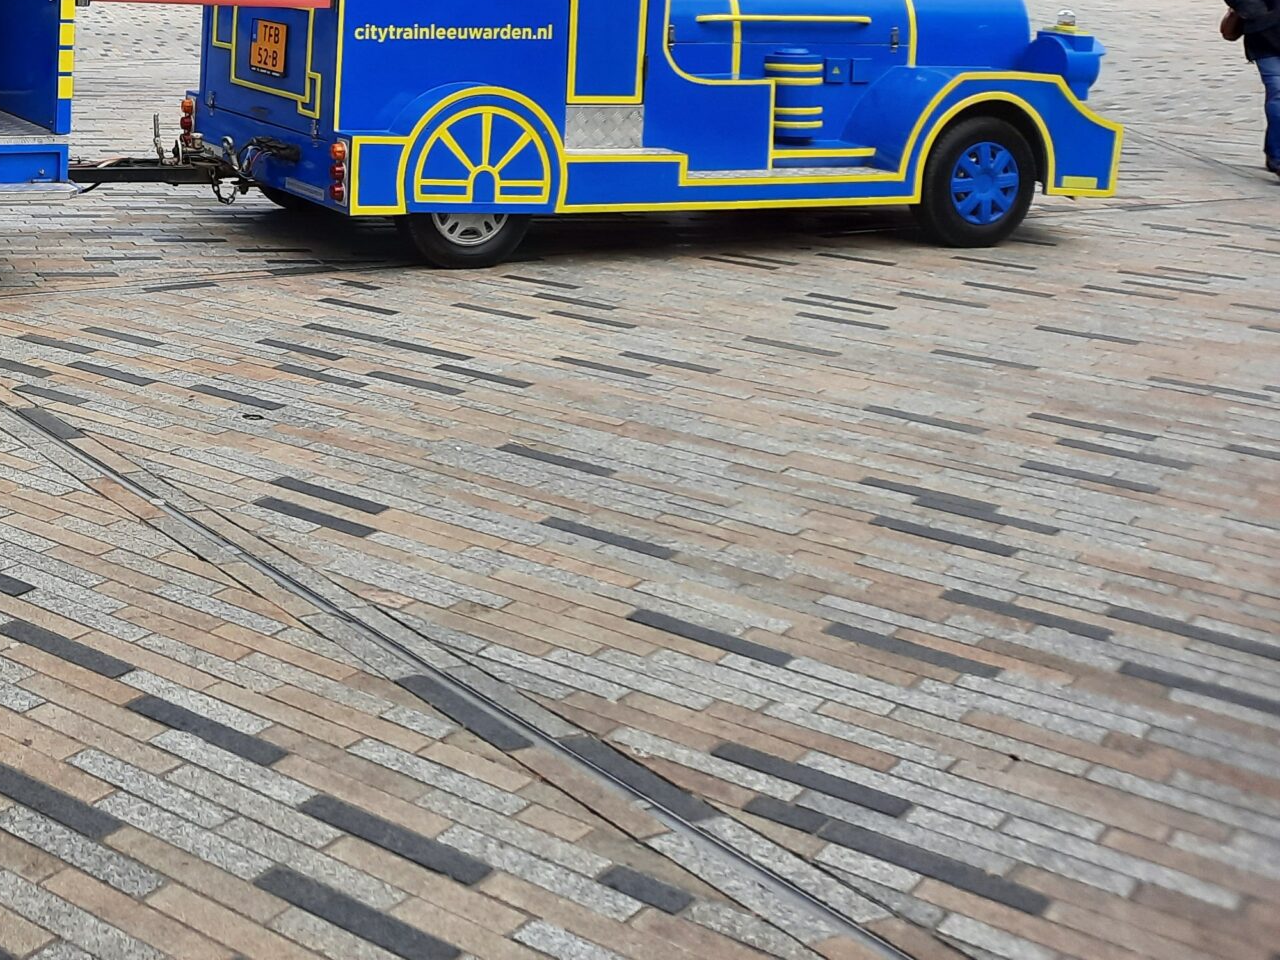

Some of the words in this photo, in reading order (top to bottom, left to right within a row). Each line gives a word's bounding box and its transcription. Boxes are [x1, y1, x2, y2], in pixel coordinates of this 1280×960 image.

[263, 24, 280, 44] TFB
[354, 24, 553, 43] citytrainleeuwarden.nl
[257, 46, 278, 68] 52-B
